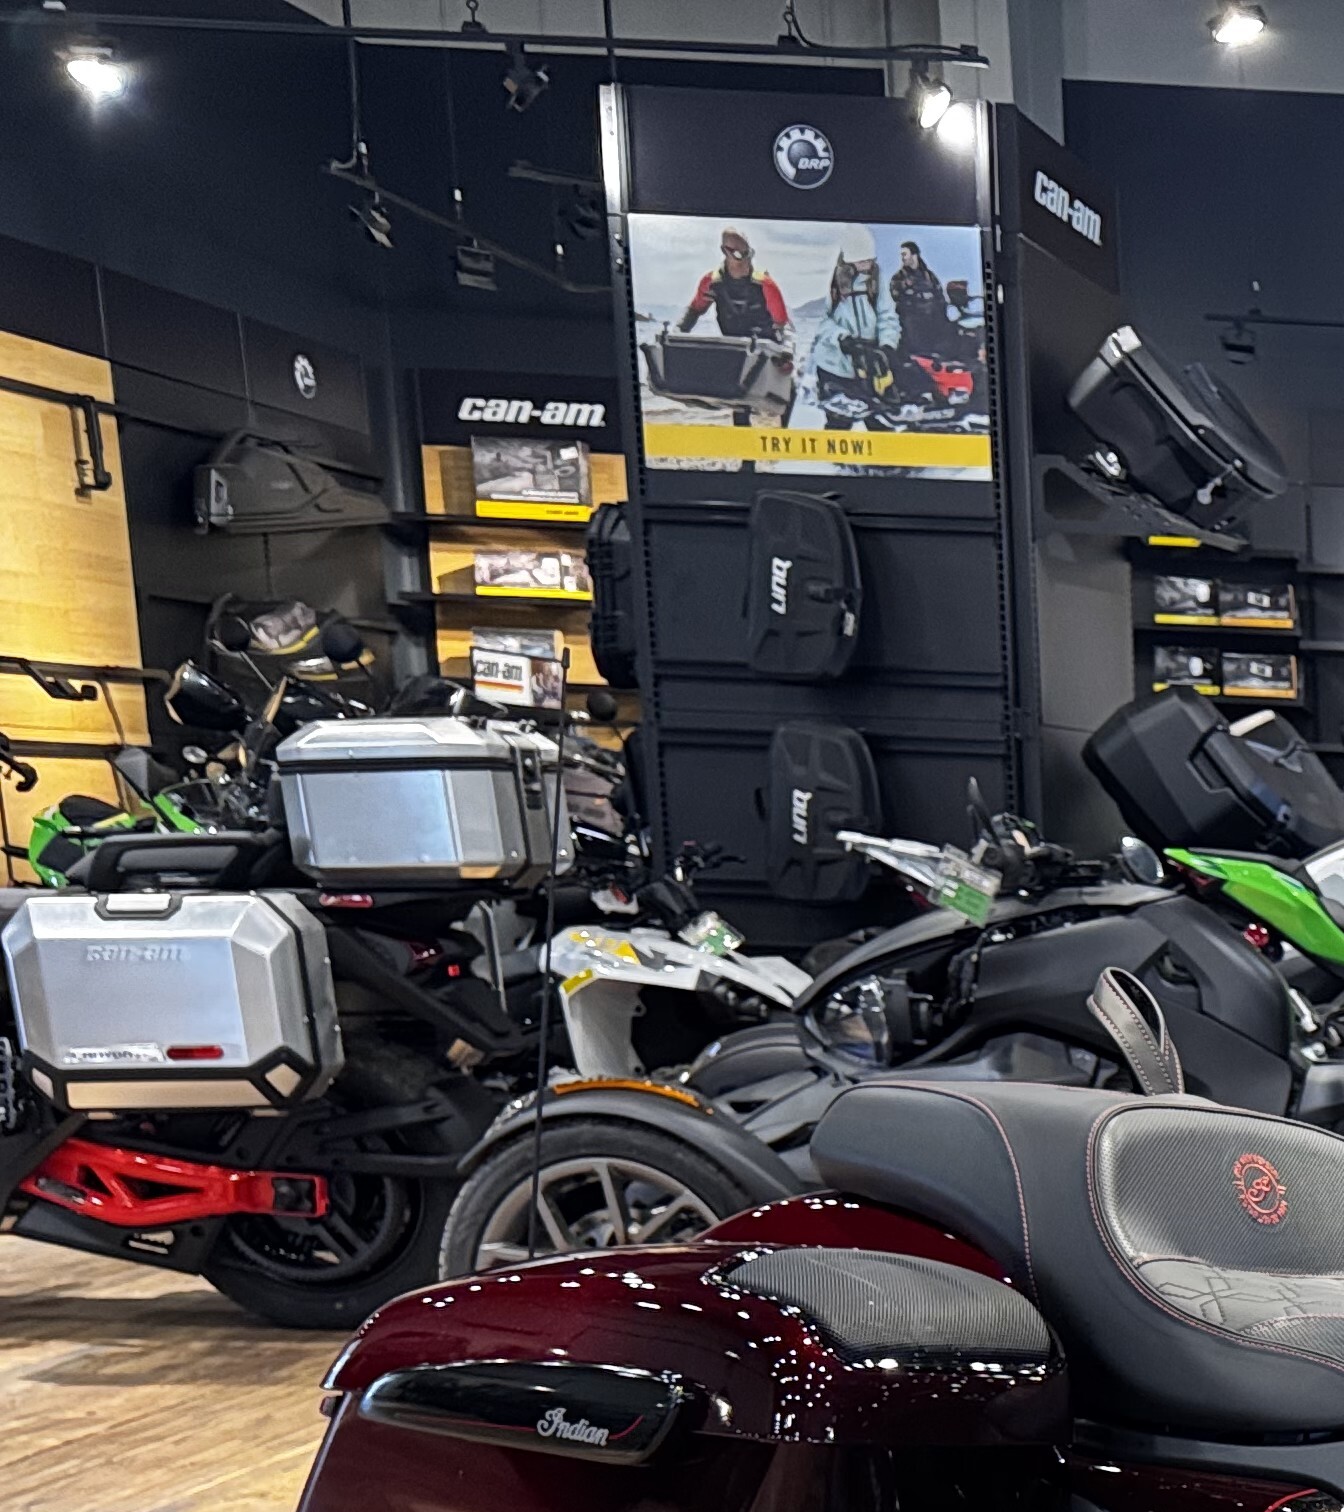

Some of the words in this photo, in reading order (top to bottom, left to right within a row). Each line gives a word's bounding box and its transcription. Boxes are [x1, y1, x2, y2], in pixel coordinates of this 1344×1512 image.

[1035, 170, 1103, 246] can-am
[458, 397, 606, 427] can-am
[760, 436, 791, 453] TRY
[801, 437, 818, 454] IT
[827, 438, 873, 456] NOW!
[537, 1407, 609, 1447] Indian
